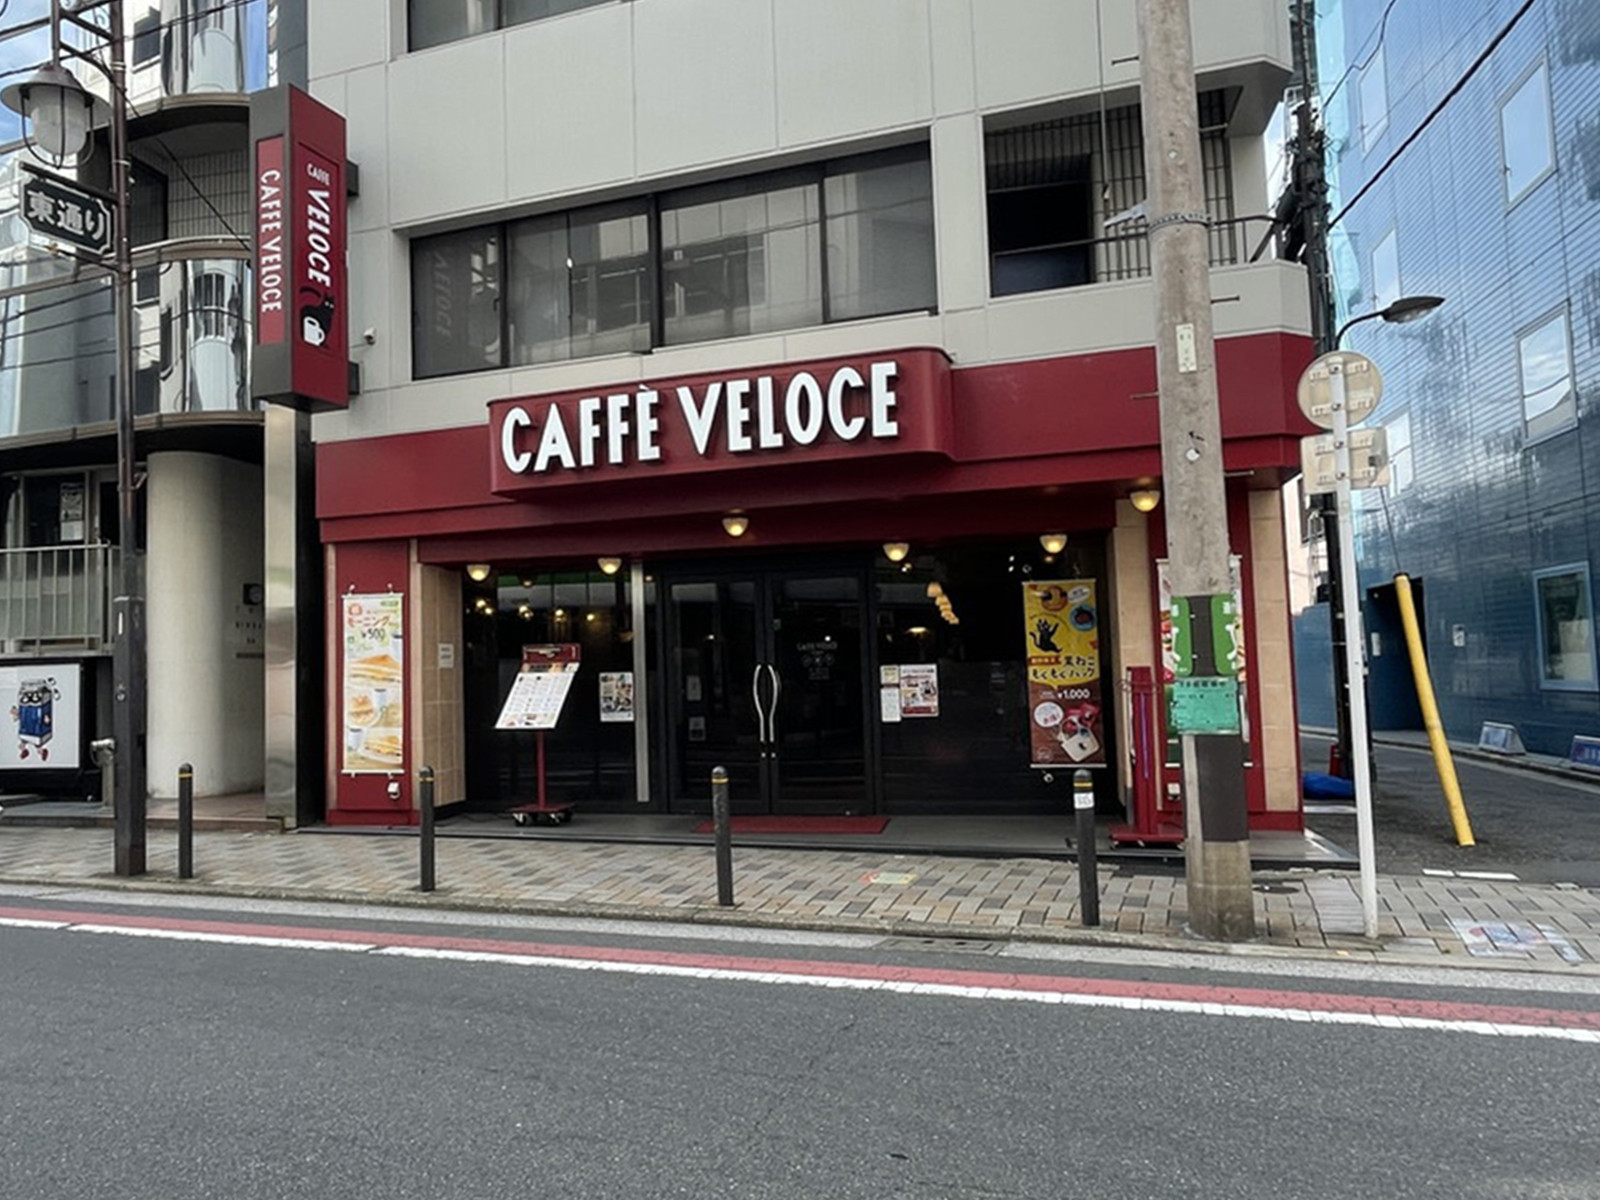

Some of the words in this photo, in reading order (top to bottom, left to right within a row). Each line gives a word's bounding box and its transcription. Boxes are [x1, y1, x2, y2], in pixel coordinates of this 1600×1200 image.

[27, 190, 105, 240] 東通り
[260, 169, 282, 233] CAFFE
[307, 189, 331, 287] VELOCE
[260, 235, 282, 313] VELOCE
[501, 384, 661, 474] CAFFÈ
[676, 361, 899, 455] VELOCE
